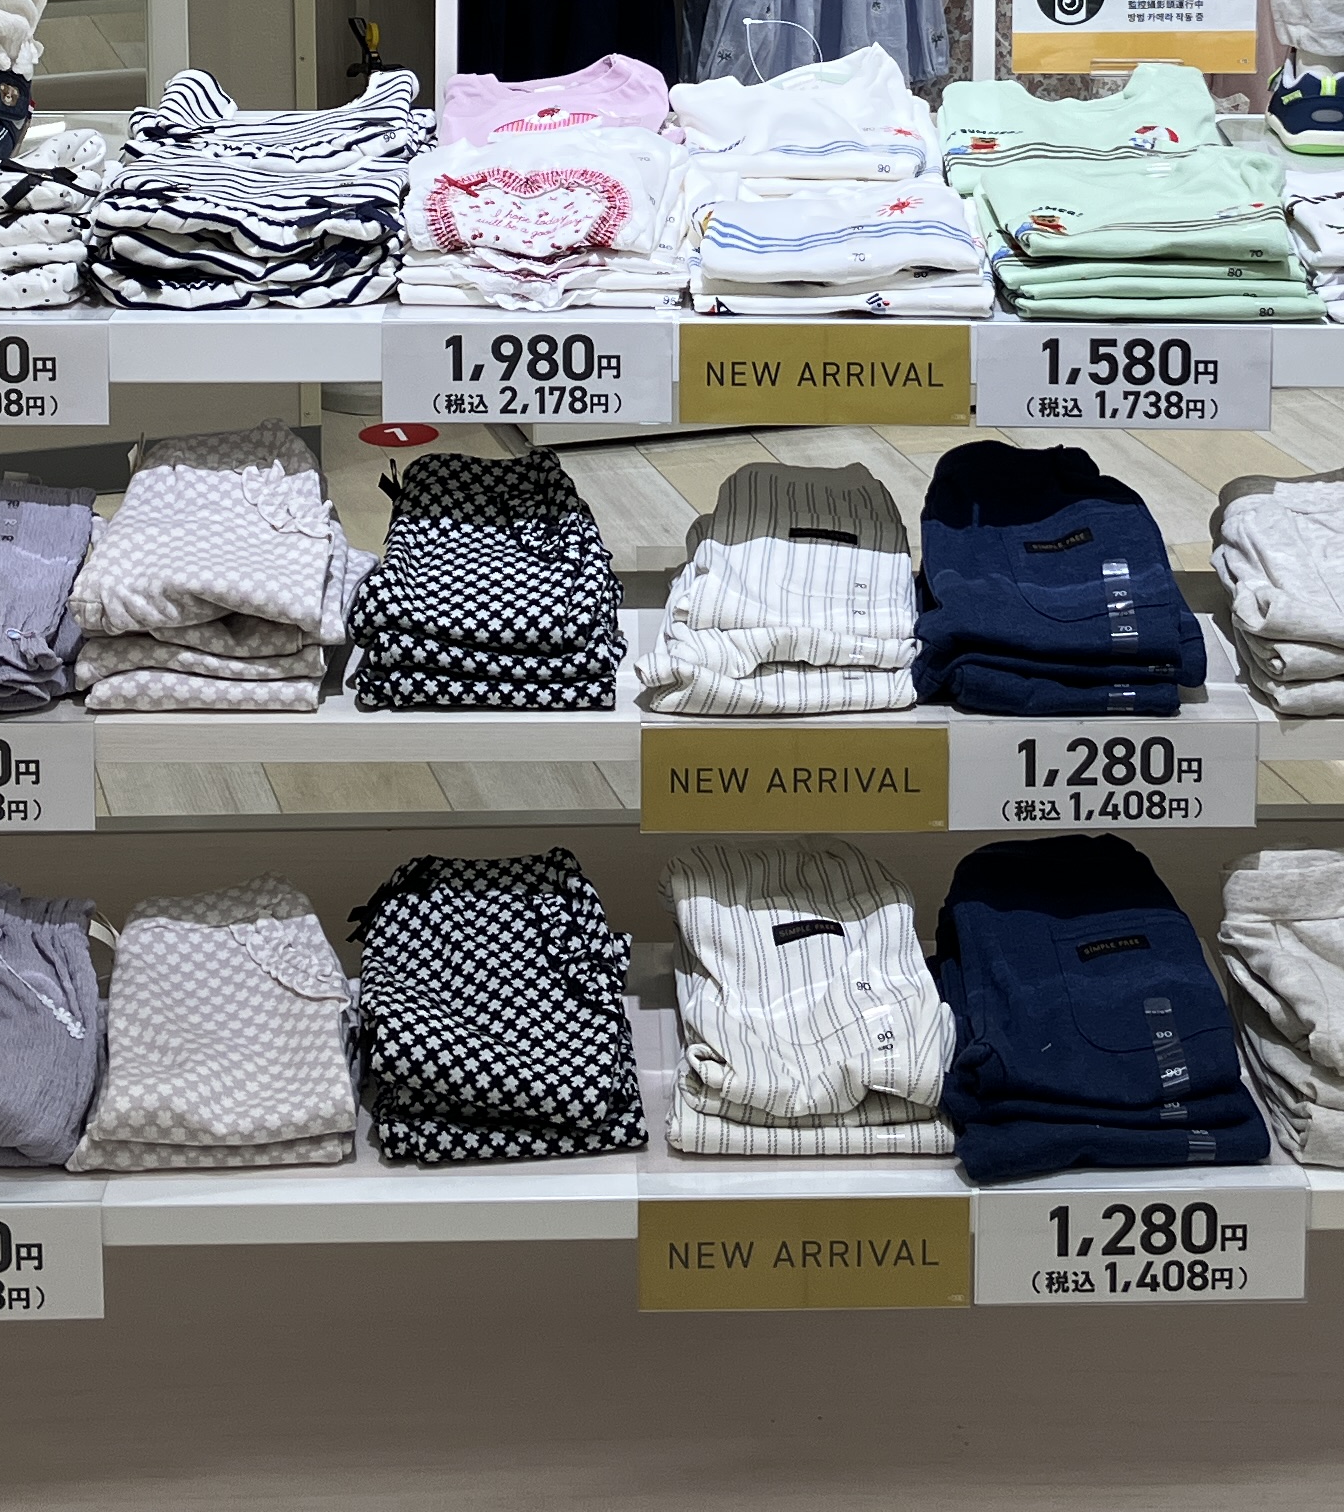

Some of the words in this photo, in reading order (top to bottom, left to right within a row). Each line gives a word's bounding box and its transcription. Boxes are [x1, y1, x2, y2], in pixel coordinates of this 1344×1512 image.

[877, 164, 891, 173] 90
[852, 253, 866, 262] 70
[1249, 249, 1264, 258] 70
[1227, 268, 1243, 278] 80
[1259, 307, 1274, 317] 80
[445, 334, 620, 381] 1,980円
[1042, 338, 1218, 386] 1,580円
[707, 362, 781, 386] NEW
[797, 362, 943, 387] ARRIVAL
[854, 582, 867, 590] 70
[1113, 590, 1127, 598] 70
[1018, 737, 1202, 787] 1,280円
[671, 768, 749, 793] NEW
[767, 768, 920, 793] ARRIVAL
[779, 925, 811, 938] SIMPLE
[1084, 942, 1115, 955] SIMPLE
[1119, 938, 1140, 947] FREE
[856, 981, 872, 992] 90
[878, 1031, 894, 1043] 90
[1156, 1031, 1173, 1039] 90
[1050, 1202, 1247, 1257] 1,280円
[669, 1242, 754, 1269] NEW
[773, 1239, 939, 1268] ARRIVAL
